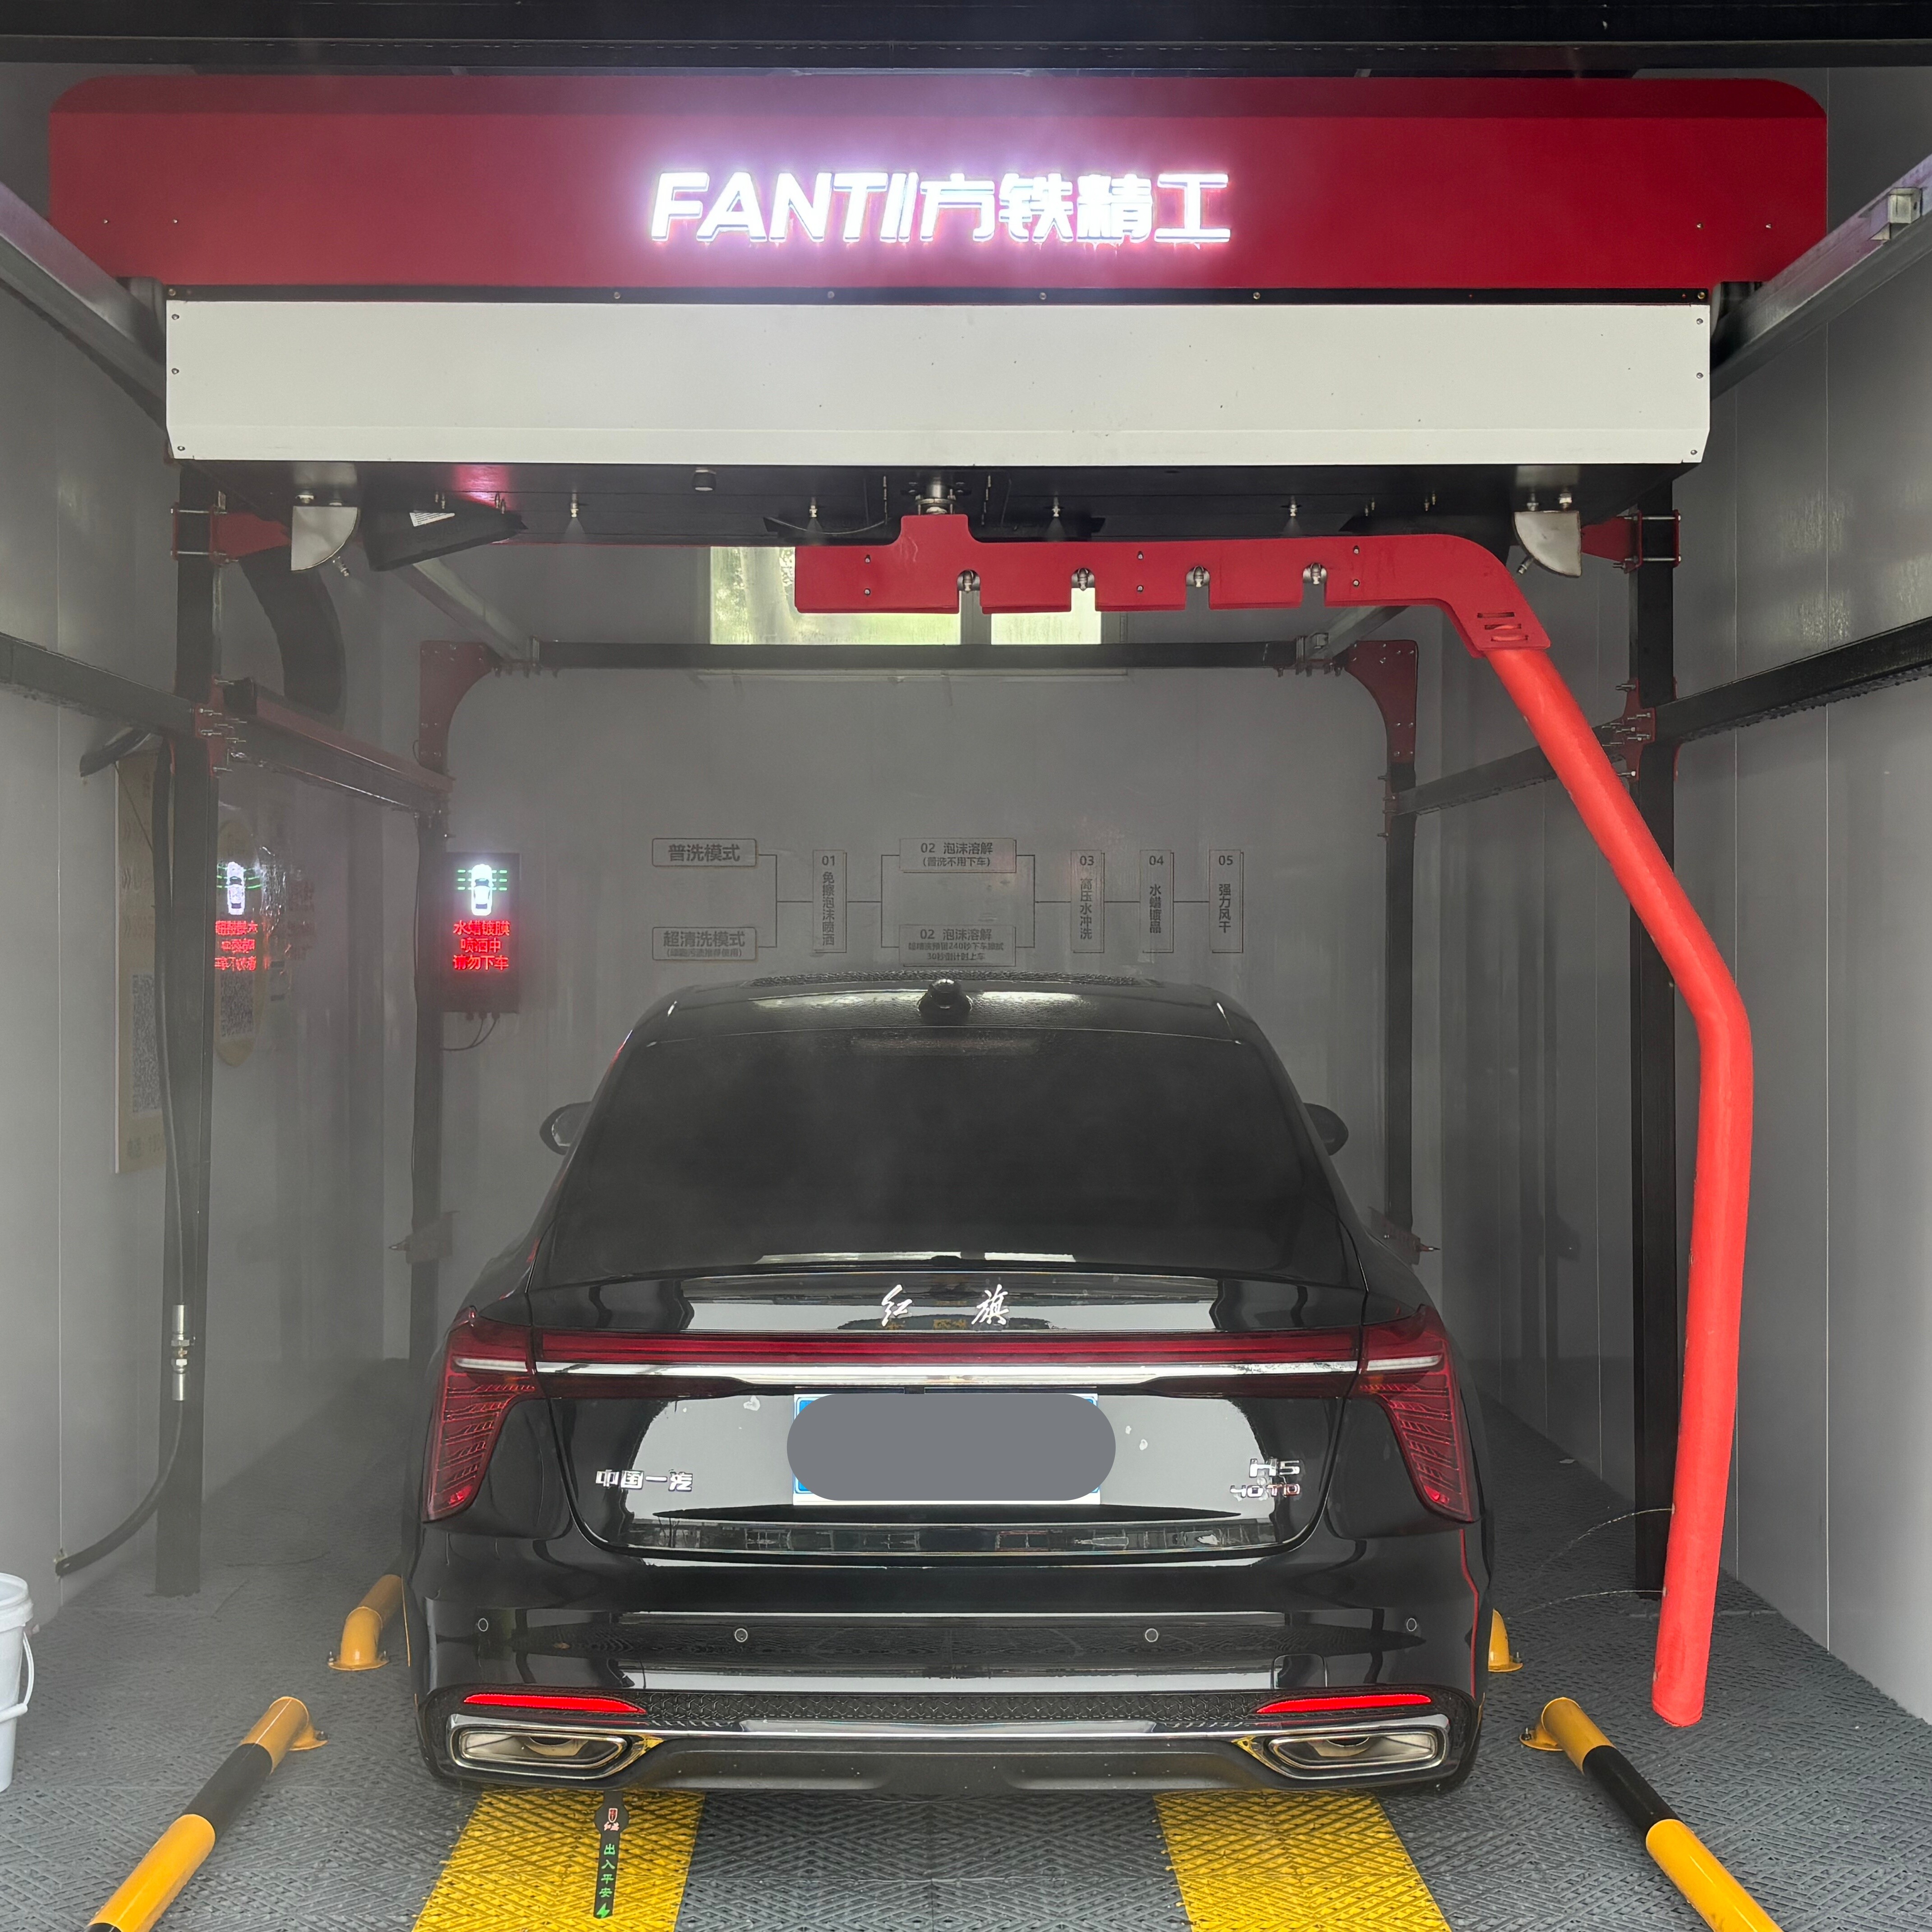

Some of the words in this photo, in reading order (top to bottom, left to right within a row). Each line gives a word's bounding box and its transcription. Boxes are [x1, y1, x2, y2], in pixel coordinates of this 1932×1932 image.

[667, 844, 741, 862] 普洗模式
[920, 842, 935, 853] 02
[943, 842, 993, 855] 泡沫溶解
[822, 855, 835, 866] 01
[1080, 856, 1095, 866] 03
[1149, 856, 1164, 866] 04
[1219, 856, 1233, 866] 05
[1080, 878, 1093, 940] 高压水冲洗
[1219, 884, 1231, 933] 强力风干
[663, 930, 745, 947] 超清洗模式
[920, 929, 935, 939] 02
[943, 929, 992, 941] 泡沫溶解
[453, 955, 509, 970] 请勿下车
[1249, 1457, 1300, 1478] H5
[595, 1469, 693, 1492] 中国一汽
[598, 1843, 616, 1898] 出入平安
